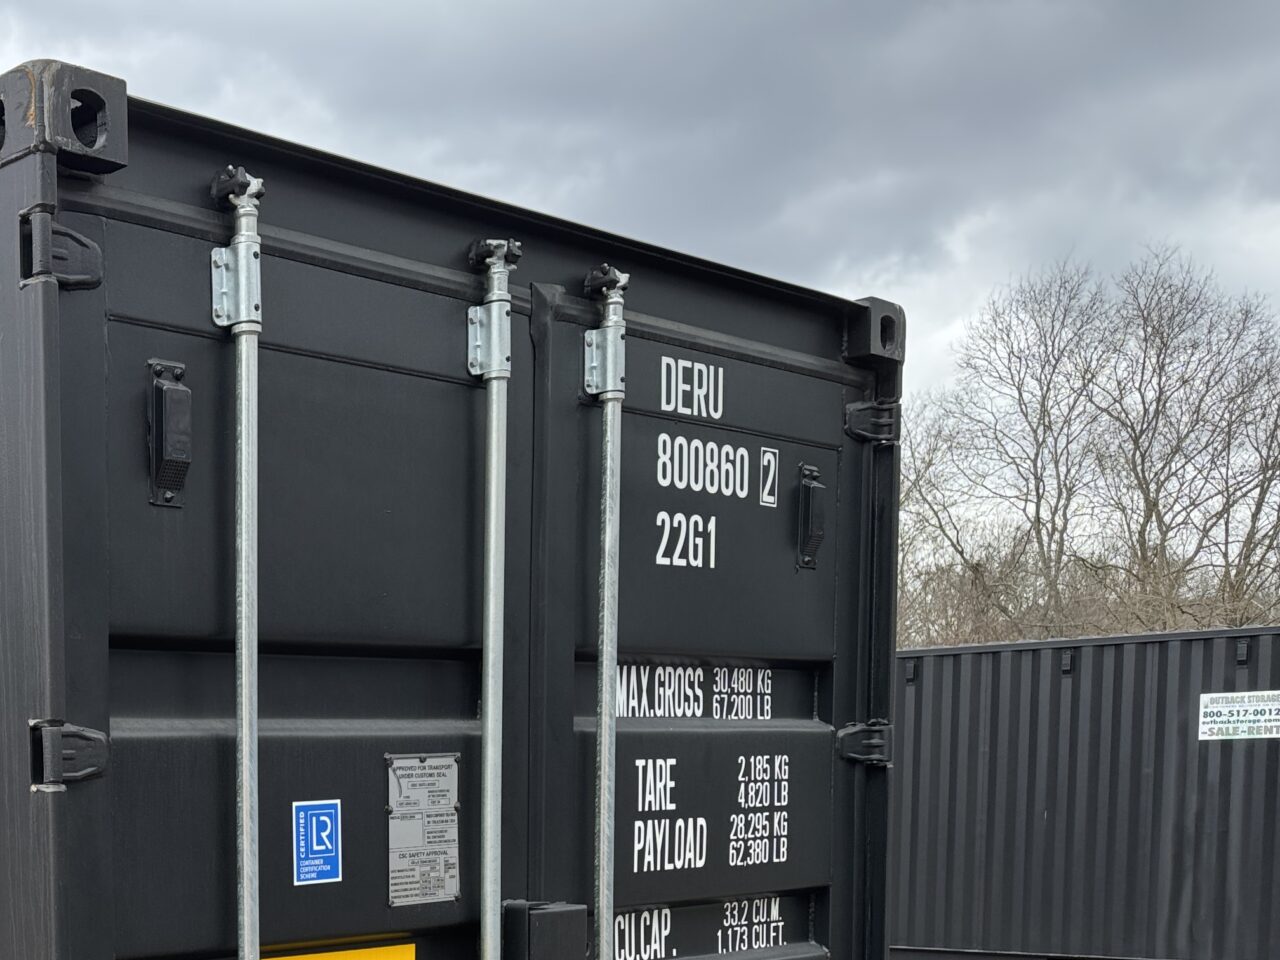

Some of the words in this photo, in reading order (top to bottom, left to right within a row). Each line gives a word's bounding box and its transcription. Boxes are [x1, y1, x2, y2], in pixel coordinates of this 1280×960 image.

[660, 355, 724, 420] DERU
[656, 432, 750, 499] 800860
[761, 450, 776, 503] 2
[655, 510, 717, 569] 22G1
[615, 664, 704, 718] MAX.GROSS
[712, 667, 754, 695] 30,480
[757, 669, 772, 694] KG
[712, 694, 754, 721] 67,200
[757, 694, 772, 720] LB
[1202, 708, 1280, 718] 800-517-0012
[1208, 726, 1240, 737] SALE
[635, 758, 677, 812] TARE
[737, 755, 771, 783] 2,185
[774, 755, 789, 780] KG
[737, 781, 771, 809] 4,820
[774, 781, 789, 807] LB
[312, 815, 332, 850] LR
[633, 817, 708, 873] PAYLOAD
[729, 812, 770, 840] 28,295
[773, 811, 788, 837] KG
[728, 838, 769, 867] 62,380
[773, 837, 788, 863] LB
[723, 900, 749, 927] 33.2
[752, 896, 783, 923] CU.M.
[717, 928, 749, 955] 1,173
[752, 921, 787, 950] CU.FT.
